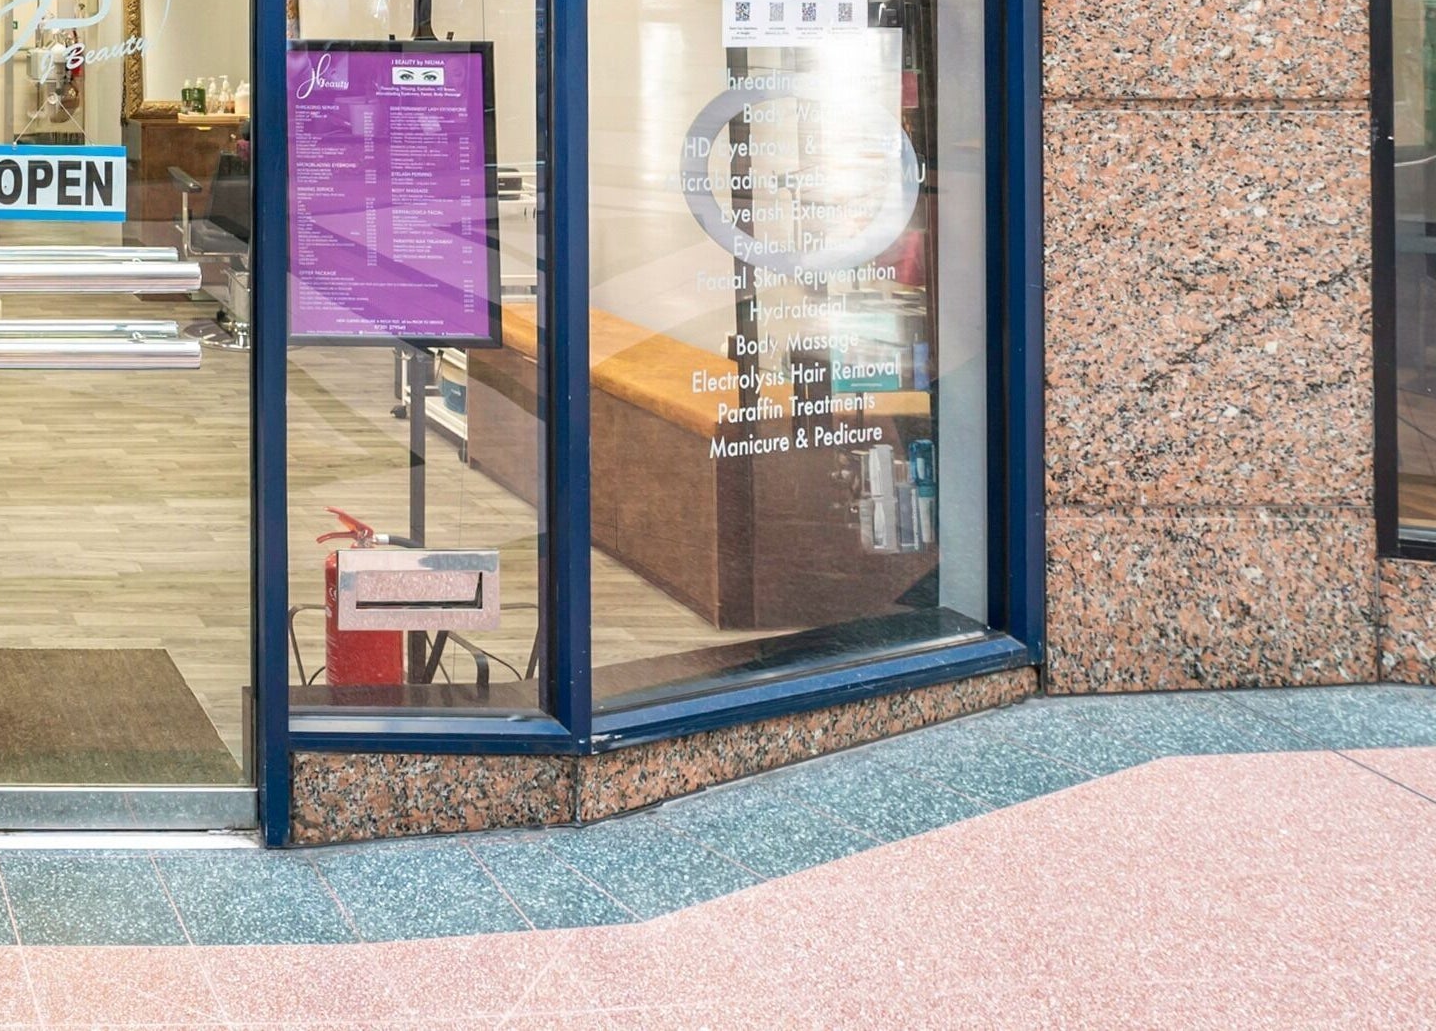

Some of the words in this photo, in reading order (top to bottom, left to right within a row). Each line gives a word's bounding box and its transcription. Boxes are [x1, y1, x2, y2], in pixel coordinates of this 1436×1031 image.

[63, 35, 149, 70] Beauty
[684, 137, 710, 158] HD
[721, 199, 784, 228] Eyelash
[733, 232, 796, 259] Eyelash
[696, 266, 746, 292] Facial
[753, 268, 787, 288] Skin
[794, 263, 896, 291] Rejuvenation
[750, 295, 847, 324] Hydrafacial
[736, 334, 778, 358] Body
[786, 331, 860, 354] Massage
[692, 366, 784, 394] Electrolysis
[791, 362, 826, 385] Hair
[832, 356, 901, 381] Removal
[718, 397, 783, 424] Paraffin
[789, 392, 875, 417] Treatments
[710, 433, 789, 458] Manicure
[795, 427, 808, 448] &
[815, 422, 883, 447] Pedicure
